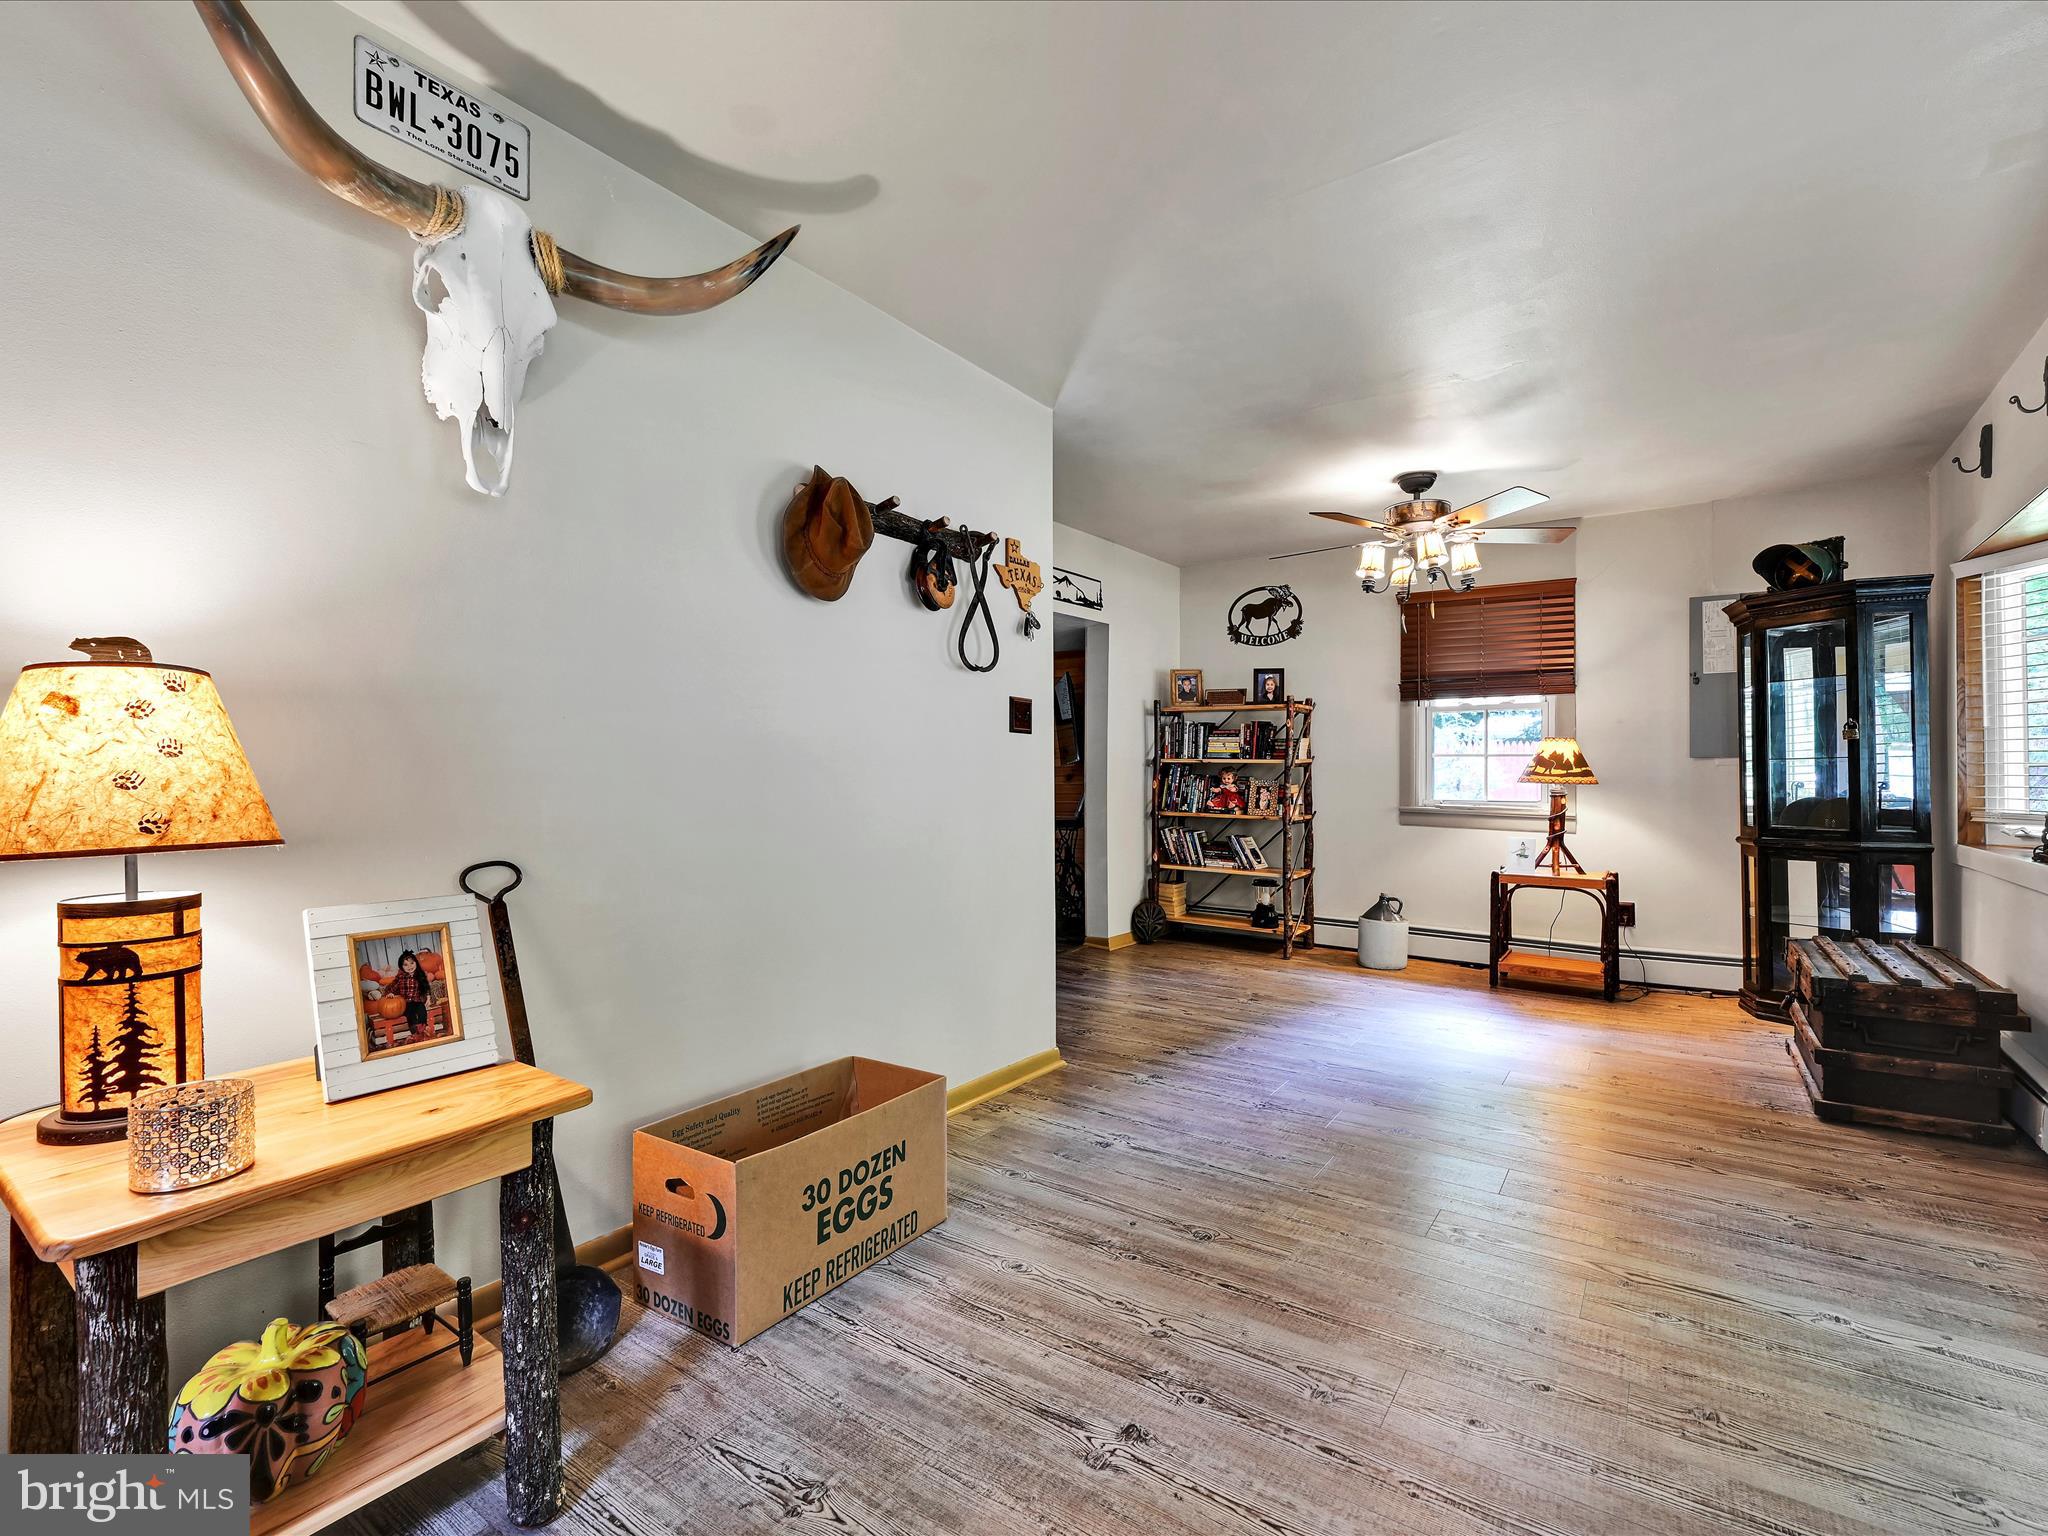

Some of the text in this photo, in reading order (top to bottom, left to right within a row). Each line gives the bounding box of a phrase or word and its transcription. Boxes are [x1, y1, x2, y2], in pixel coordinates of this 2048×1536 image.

[414, 70, 481, 118] TEXAS
[366, 68, 519, 179] BWL 3075
[406, 130, 487, 174] The Lone Star State
[1008, 567, 1038, 588] TEXAS
[1240, 631, 1290, 646] WELCOME
[685, 1120, 704, 1133] Safety
[706, 1114, 718, 1124] and
[718, 1107, 741, 1121] Quality
[801, 1139, 906, 1212] 30 DOZEN
[638, 1201, 706, 1238] KEEP REFRIGERATED
[817, 1174, 894, 1246] EGGS
[640, 1256, 663, 1270] LARGE
[783, 1209, 918, 1313] KEEP REFRIGERATED
[635, 1283, 730, 1341] 30 DOZEN EGGS
